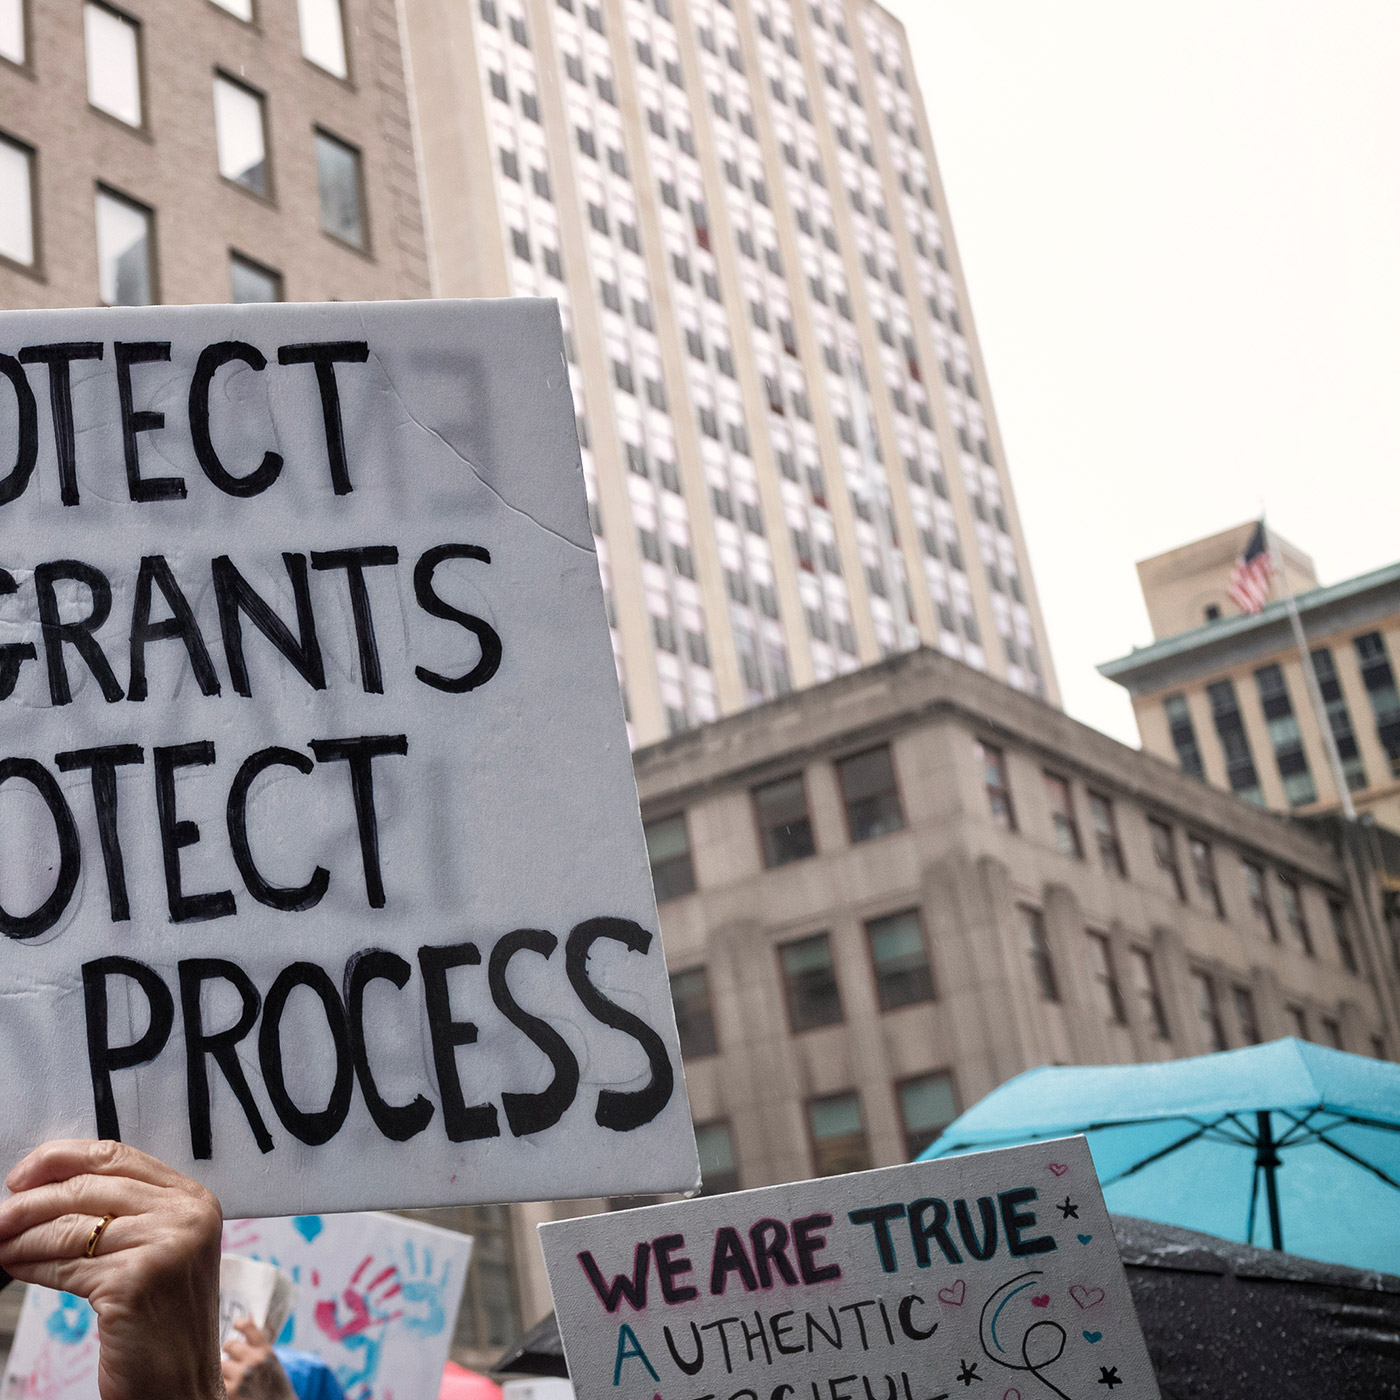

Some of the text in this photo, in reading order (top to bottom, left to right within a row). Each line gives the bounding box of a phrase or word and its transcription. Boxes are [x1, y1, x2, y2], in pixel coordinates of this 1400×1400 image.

[80, 916, 675, 1161] PROCESS
[575, 1185, 1059, 1315] WE ARE TRUE
[613, 1293, 939, 1387] AUTHENTIC
